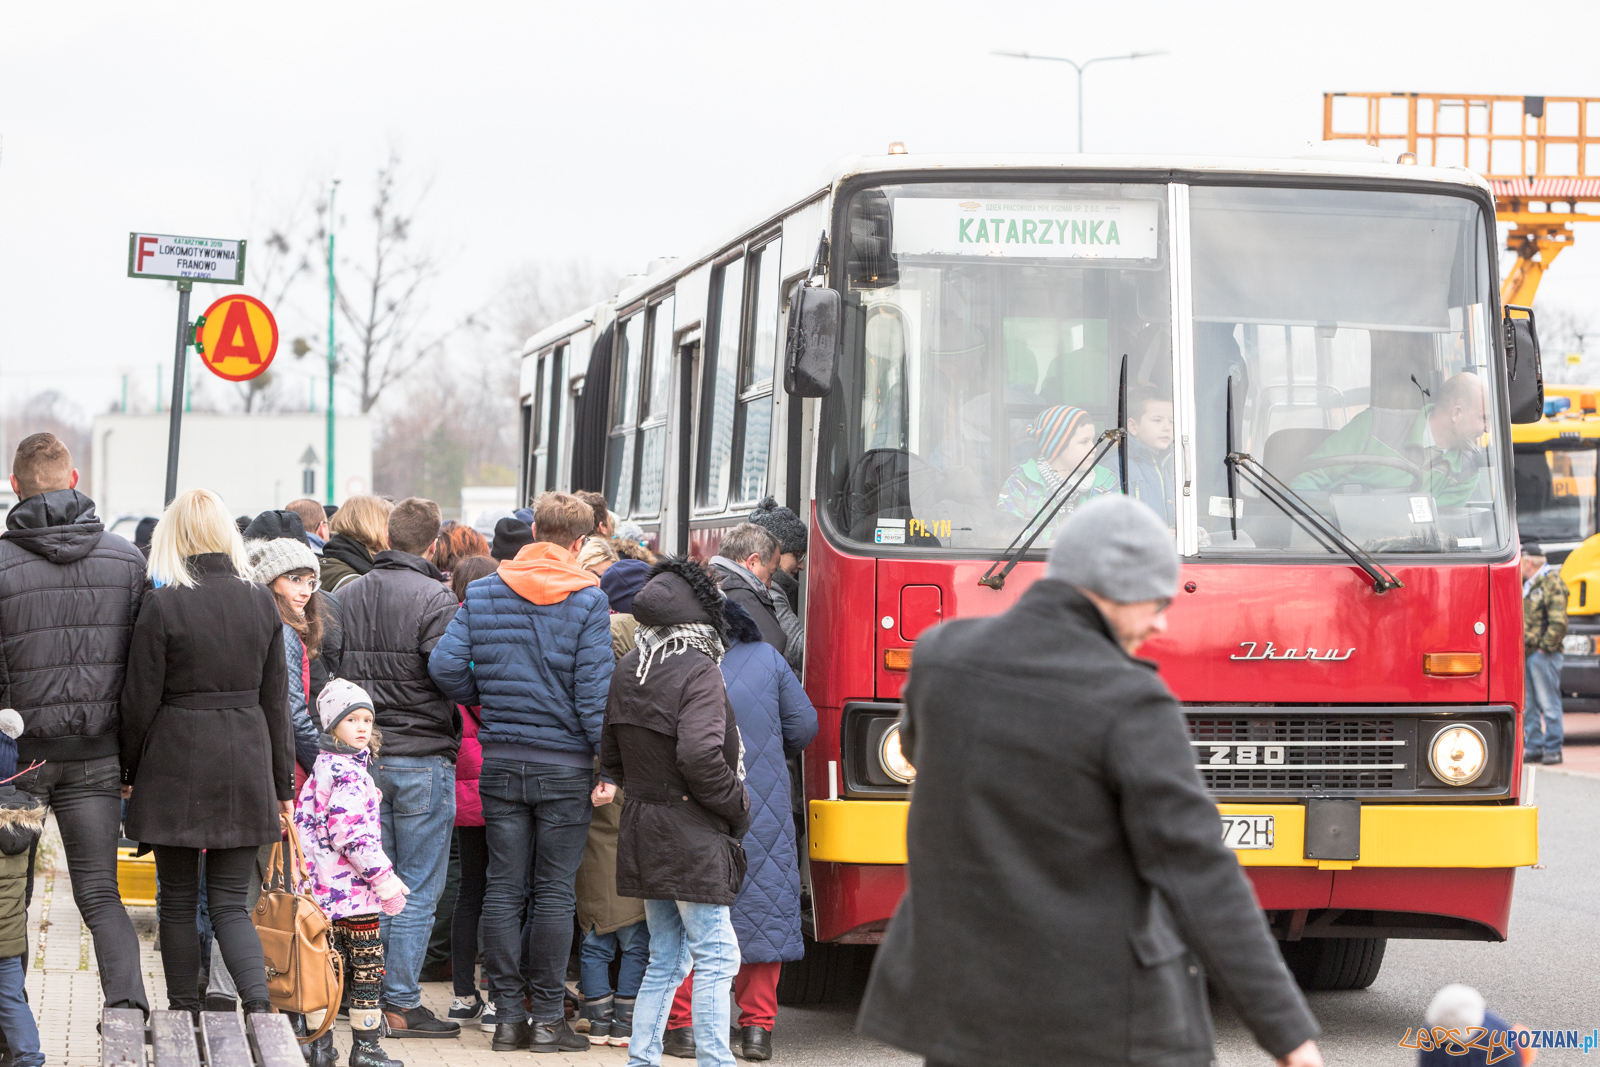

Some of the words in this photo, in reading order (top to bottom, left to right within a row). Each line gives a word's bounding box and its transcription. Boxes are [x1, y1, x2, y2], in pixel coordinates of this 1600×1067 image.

[1038, 204, 1049, 212] MPK
[958, 217, 1121, 246] KATARZYNKA
[173, 238, 208, 247] KATARZYNKA
[137, 236, 159, 272] F
[159, 245, 236, 260] LOKOMOTYWOWNIA
[177, 259, 217, 271] FRANOWO
[211, 300, 262, 365] A
[1230, 641, 1356, 660] Ikarus
